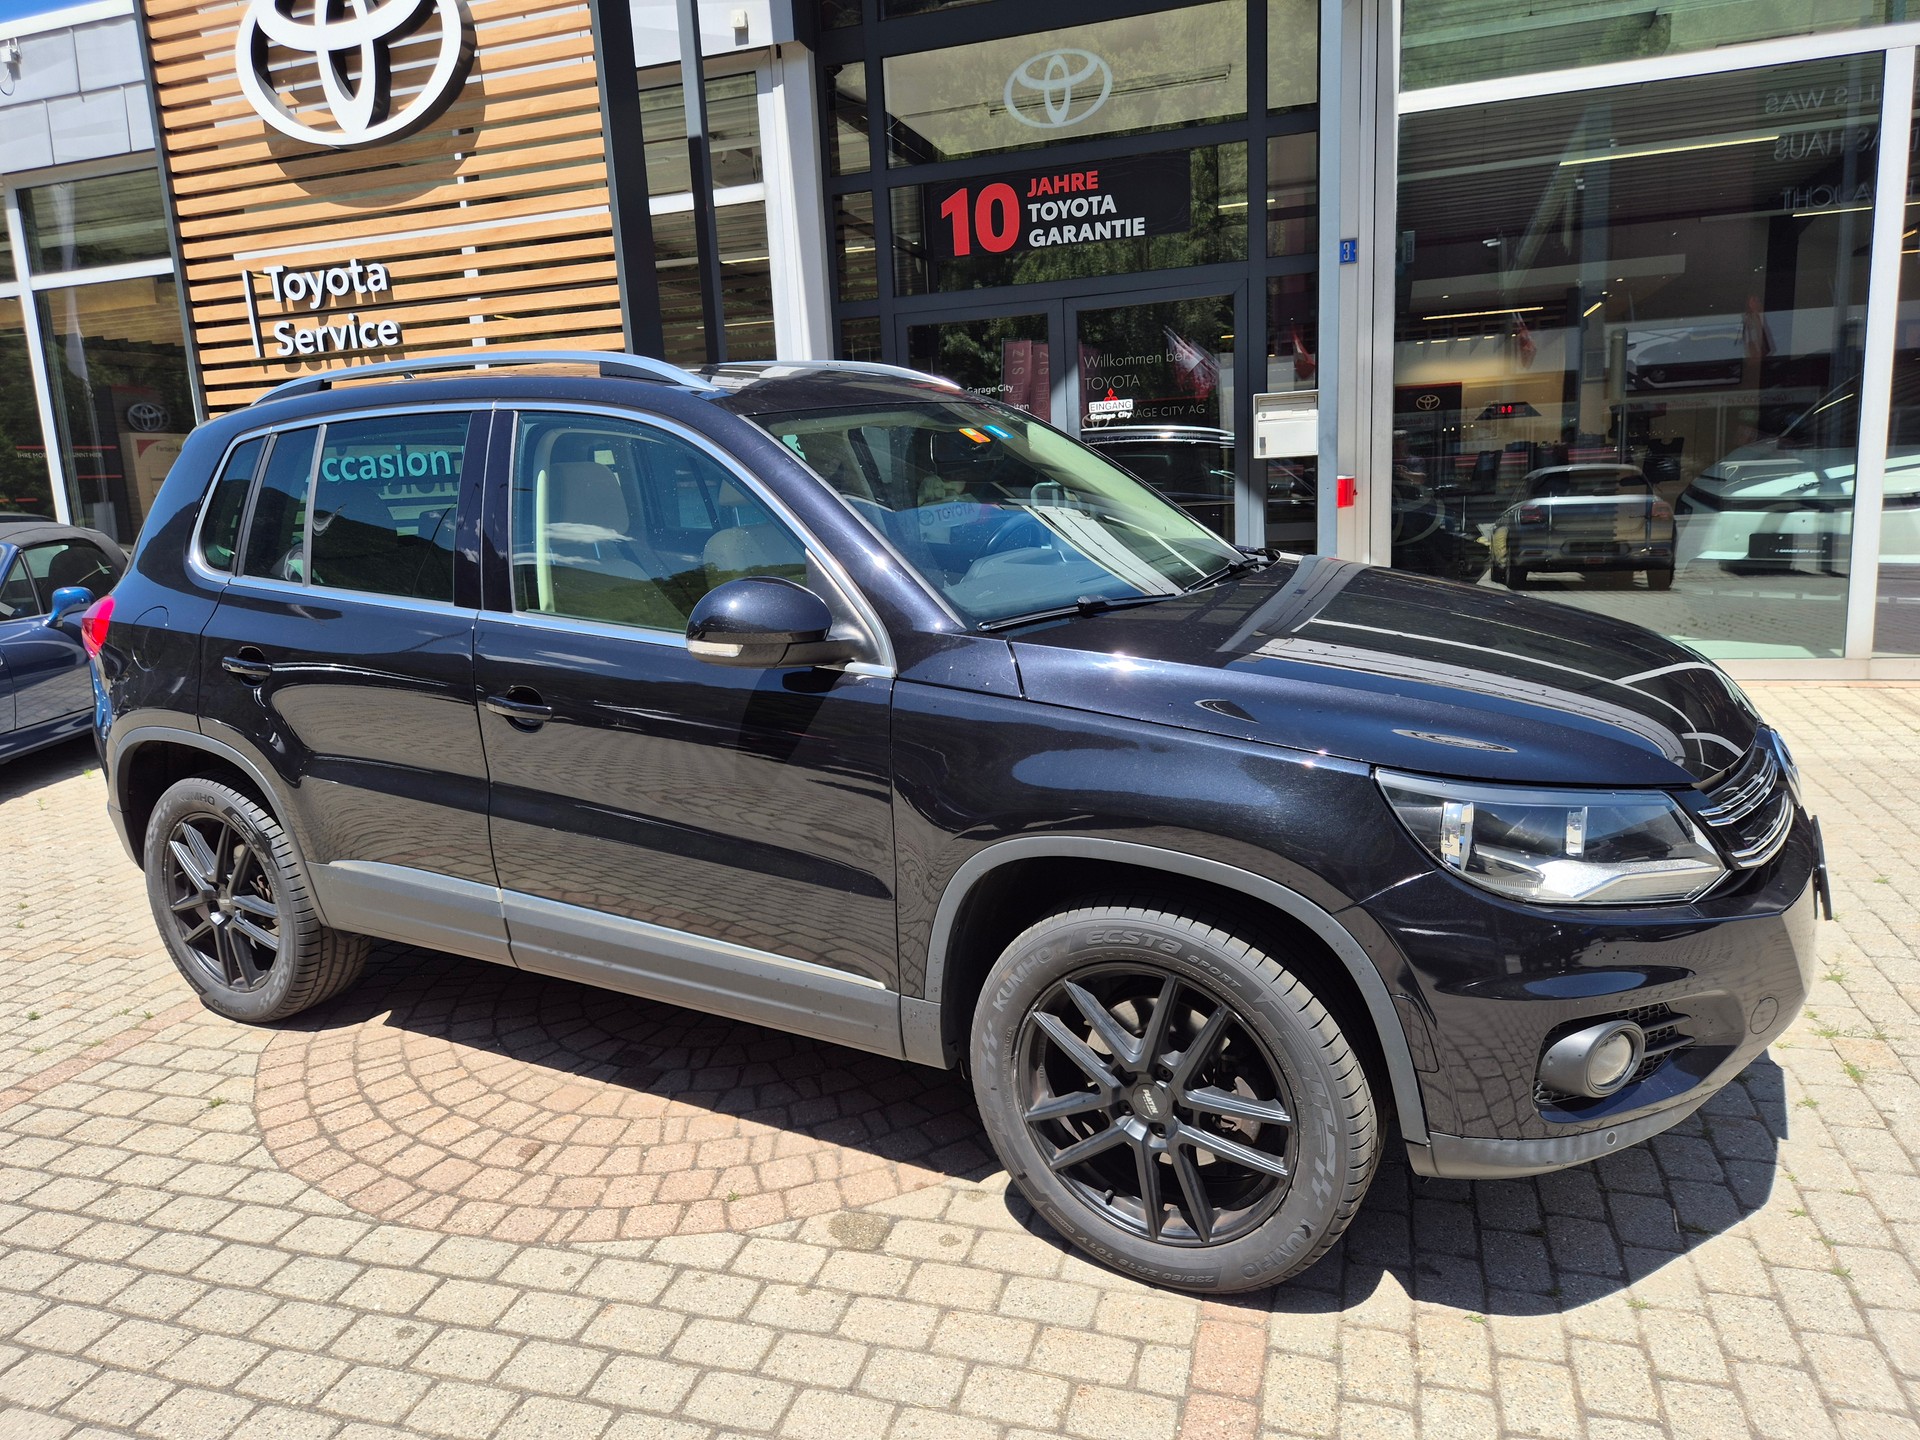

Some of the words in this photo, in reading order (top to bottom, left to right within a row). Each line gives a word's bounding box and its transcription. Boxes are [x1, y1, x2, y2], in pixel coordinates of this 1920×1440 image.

[1026, 170, 1099, 198] JAHRE
[941, 182, 1020, 257] 10
[1027, 194, 1118, 223] TOYOTA
[1028, 217, 1146, 248] GARANTIE
[1343, 242, 1350, 261] 3
[263, 258, 388, 309] Toyota
[273, 312, 399, 356] Service
[1083, 352, 1162, 369] Willkommen
[966, 386, 996, 395] Garage
[997, 383, 1014, 393] City
[1084, 374, 1140, 391] TOYOTA
[1090, 400, 1132, 412] EINGANG
[1117, 411, 1133, 419] City
[1160, 405, 1185, 416] CITY
[1188, 404, 1205, 414] AG
[319, 444, 451, 482] ccasion
[992, 945, 1054, 1013] KUMHO
[1187, 954, 1242, 989] SPORT
[1142, 1089, 1159, 1114] PLATIN
[1240, 1218, 1316, 1280] KUMHO
